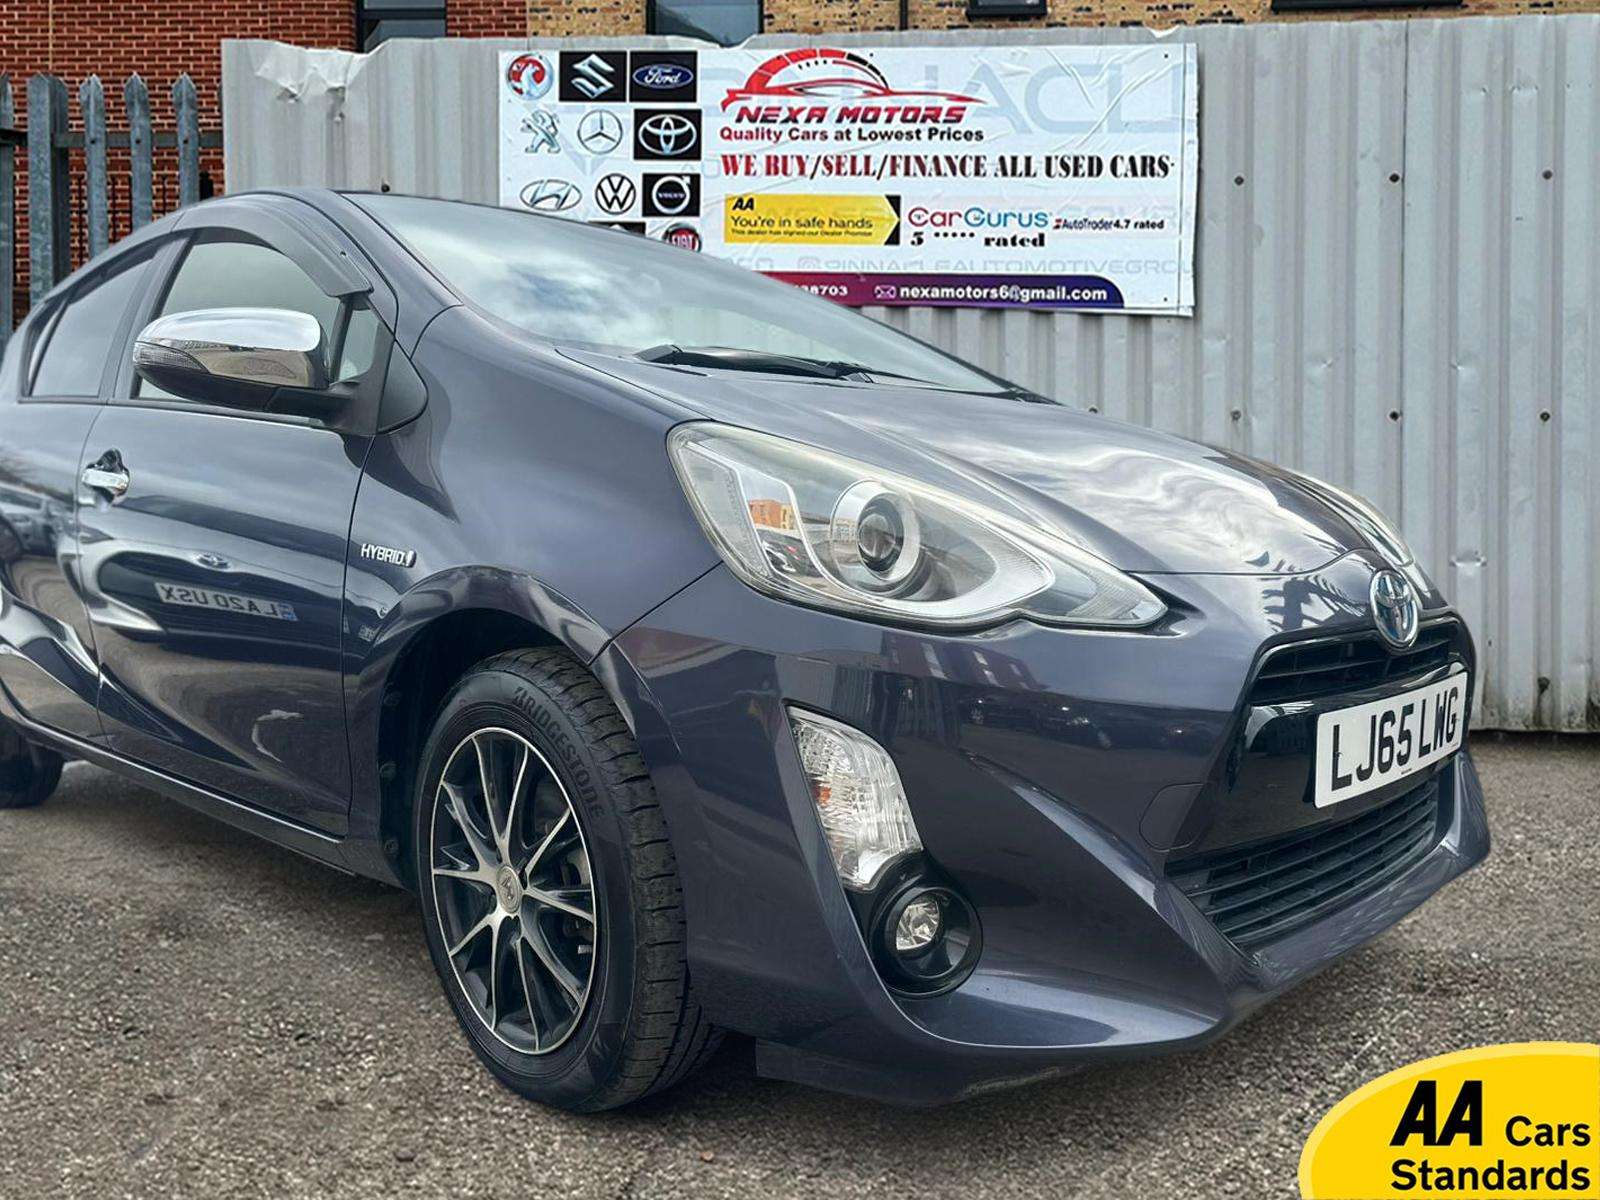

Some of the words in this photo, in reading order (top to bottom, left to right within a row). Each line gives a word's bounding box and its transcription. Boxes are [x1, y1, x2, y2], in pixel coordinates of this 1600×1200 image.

[644, 65, 682, 84] Ford
[735, 106, 824, 124] NEXA
[835, 106, 967, 124] MOTORS
[720, 127, 782, 144] Quality
[788, 127, 828, 142] Cars
[834, 127, 851, 142] at
[857, 127, 922, 142] Lowest
[928, 127, 984, 142] Prices
[721, 154, 757, 177] WE
[994, 154, 1037, 177] ALL
[1044, 154, 1109, 177] USED
[1110, 154, 1170, 178] CARS
[732, 197, 754, 210] AA
[731, 216, 775, 228] You're
[778, 216, 791, 228] in
[795, 216, 826, 229] safe
[828, 216, 873, 229] hands
[908, 207, 1049, 228] CarGurus
[1133, 219, 1164, 230] rated
[910, 231, 924, 246] 5
[984, 232, 1045, 247] rated
[1331, 703, 1415, 792] LJ65
[1418, 686, 1459, 758] LWG
[512, 686, 605, 818] BRIDGESTONE
